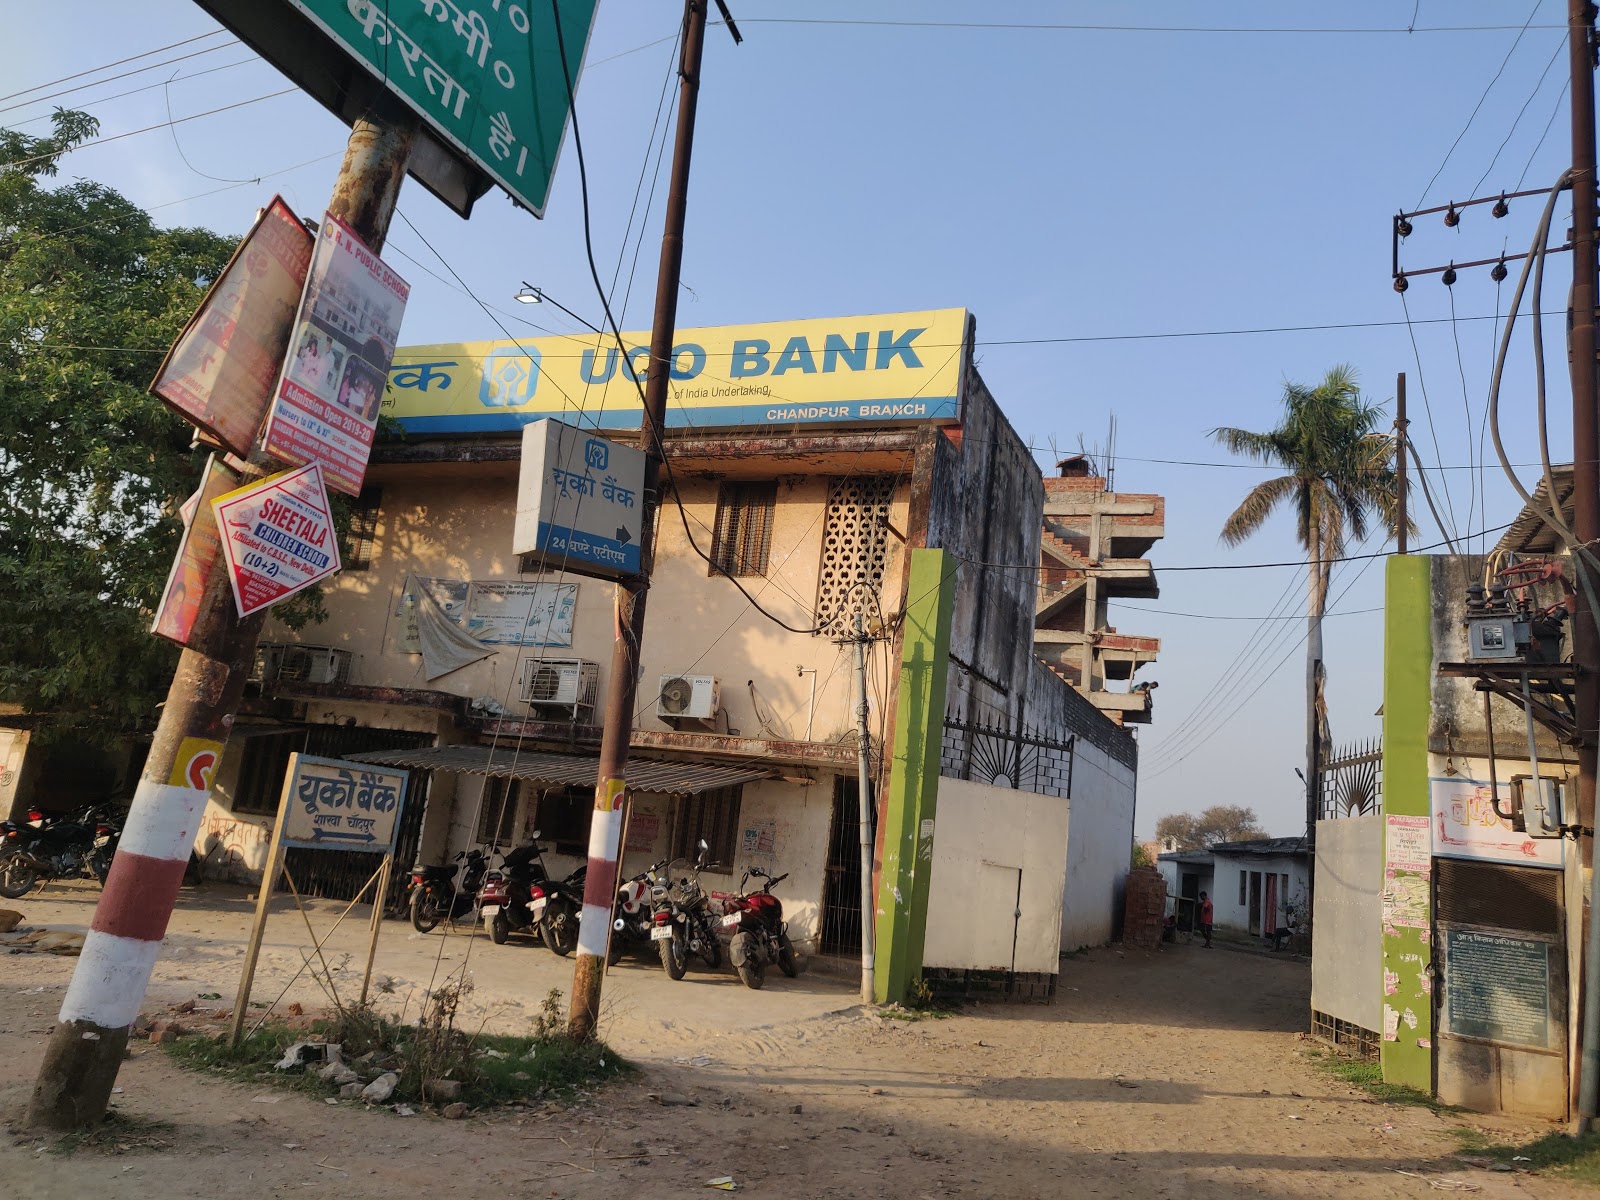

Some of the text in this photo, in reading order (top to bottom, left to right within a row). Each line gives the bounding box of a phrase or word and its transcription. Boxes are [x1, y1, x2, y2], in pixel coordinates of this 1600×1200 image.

[333, 229, 344, 246] R.
[344, 238, 354, 255] N.
[354, 246, 382, 278] PUBLIC
[381, 269, 409, 301] SCHOOL
[580, 328, 927, 384] UCO BANK
[674, 389, 684, 399] of
[685, 387, 709, 399] India
[276, 403, 300, 425] Nursery
[299, 415, 307, 426] to
[285, 382, 324, 416] Admission
[322, 405, 343, 429] Open
[342, 415, 371, 442] 2019-20
[767, 404, 926, 420] CHANDPUR BRANCH
[295, 478, 320, 495] ADMISSION
[297, 489, 310, 501] FREE
[552, 468, 636, 508] यूको बैंक
[258, 497, 329, 547] SHEETALA
[232, 530, 260, 549] Affiliated
[259, 543, 268, 553] to
[288, 559, 301, 569] New
[301, 564, 315, 576] Delhi
[258, 525, 326, 566] CHILDREN SCHOOL
[552, 537, 626, 564] 24 घण्टे एटीएम
[242, 551, 279, 577] (10+2)
[299, 770, 396, 814] यूको बैंक
[314, 814, 342, 827] शाखा
